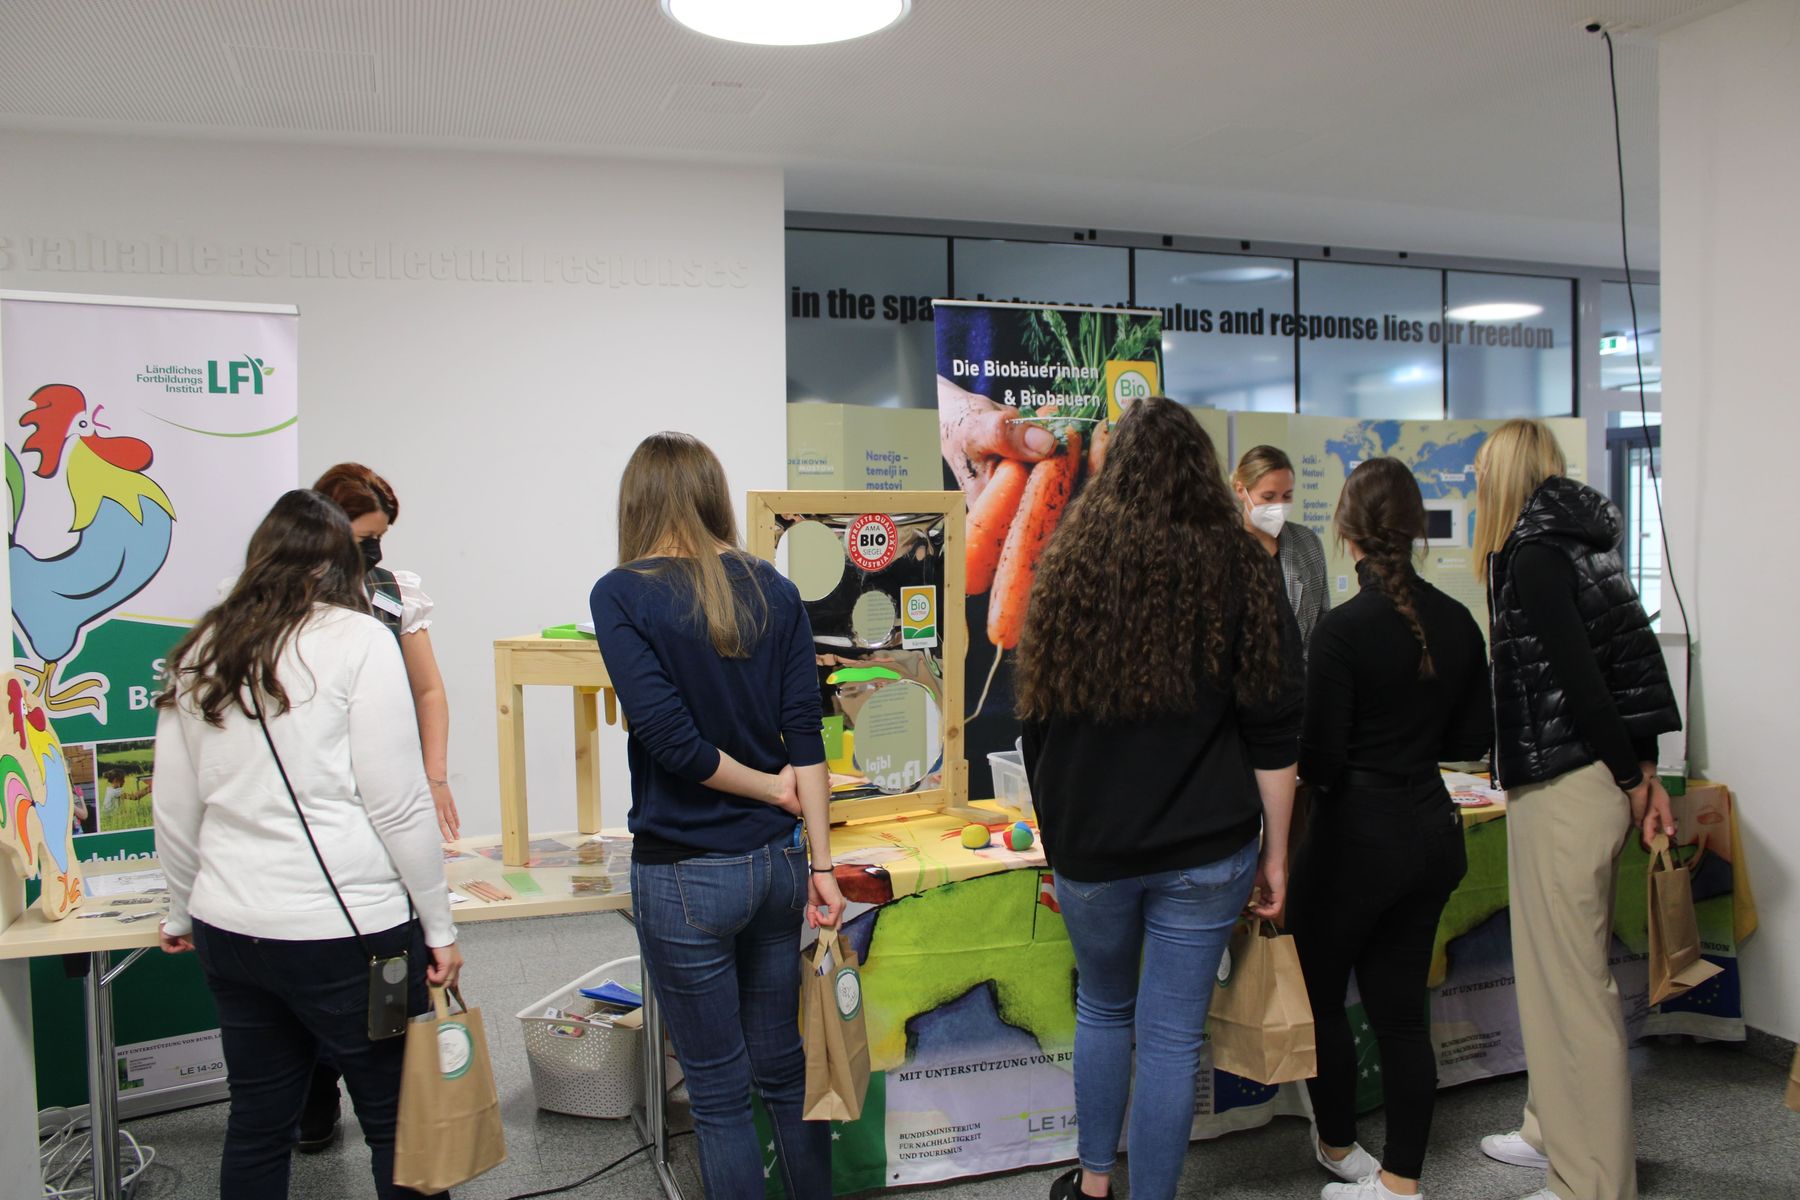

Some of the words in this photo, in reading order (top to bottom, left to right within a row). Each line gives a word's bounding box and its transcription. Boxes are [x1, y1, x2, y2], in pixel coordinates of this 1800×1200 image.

[543, 252, 750, 289] responses
[792, 286, 820, 318] in
[827, 288, 876, 320] the
[1219, 308, 1264, 335] and
[1270, 312, 1379, 341] response
[1383, 314, 1424, 343] lies
[1428, 321, 1465, 345] our
[1468, 320, 1555, 350] freedom
[145, 364, 204, 375] Ländliches
[952, 359, 980, 377] Die
[983, 359, 1100, 379] Biobäuerinnen
[136, 374, 204, 385] Fortbildungs
[165, 384, 204, 394] Institut
[1120, 378, 1145, 398] Bio
[1003, 389, 1017, 406] &
[1020, 389, 1101, 408] Biobauern
[865, 466, 897, 479] temelji
[899, 465, 908, 476] in
[866, 479, 902, 490] mostovi
[860, 533, 886, 546] BIO
[862, 548, 883, 556] SIEGEL
[857, 556, 889, 568] AUSTRIA
[911, 599, 927, 611] Bio
[1441, 986, 1459, 998] MIT
[179, 1066, 195, 1077] LE
[196, 1061, 224, 1073] 14-20
[899, 1069, 923, 1082] MIT
[925, 1056, 1028, 1079] UNTERSTÜTZUNG
[1029, 1053, 1055, 1065] VON
[899, 1122, 982, 1141] BUNDESMINISTERIUM
[1028, 1116, 1055, 1133] LE
[915, 1132, 982, 1149] NACHHALTIGKEIT
[899, 1150, 918, 1160] UND
[919, 1145, 963, 1159] TOURISMUS
